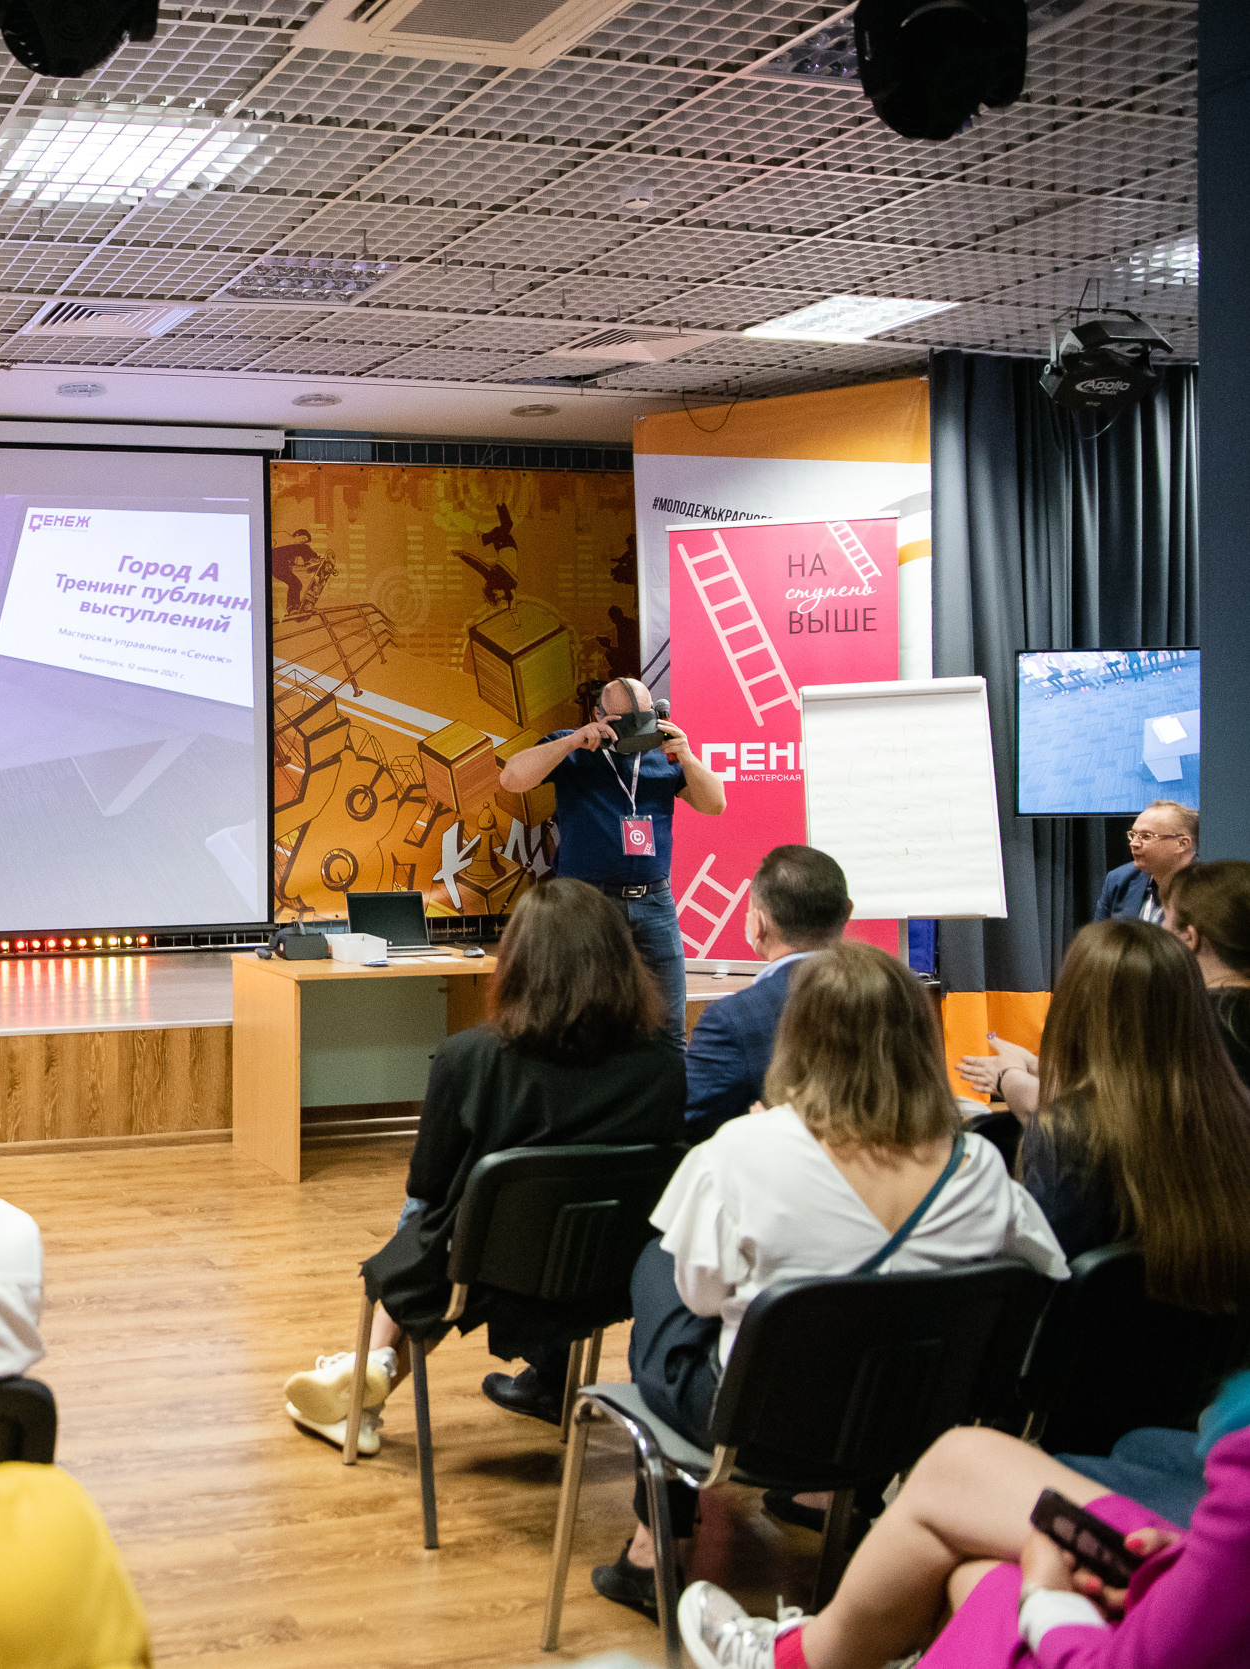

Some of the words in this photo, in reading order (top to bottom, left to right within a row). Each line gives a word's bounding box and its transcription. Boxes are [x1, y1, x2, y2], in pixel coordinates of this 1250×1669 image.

[1083, 379, 1131, 391] Apollo
[652, 496, 774, 521] #МОЛОДЕЖЬКРАС
[29, 514, 92, 532] СЕНЕЖ
[118, 555, 192, 584] Город
[198, 562, 219, 582] А
[788, 553, 827, 577] НА
[56, 573, 137, 596] Тренинг
[786, 585, 877, 614] ступень
[79, 601, 232, 633] выступлений
[789, 608, 877, 634] ВЫШЕ
[58, 627, 112, 643] Мастерская
[115, 638, 177, 655] управления
[180, 648, 232, 664] «Сенеж»
[701, 742, 806, 781] СЕН
[740, 773, 801, 782] МАСТЕРСКАЯ
